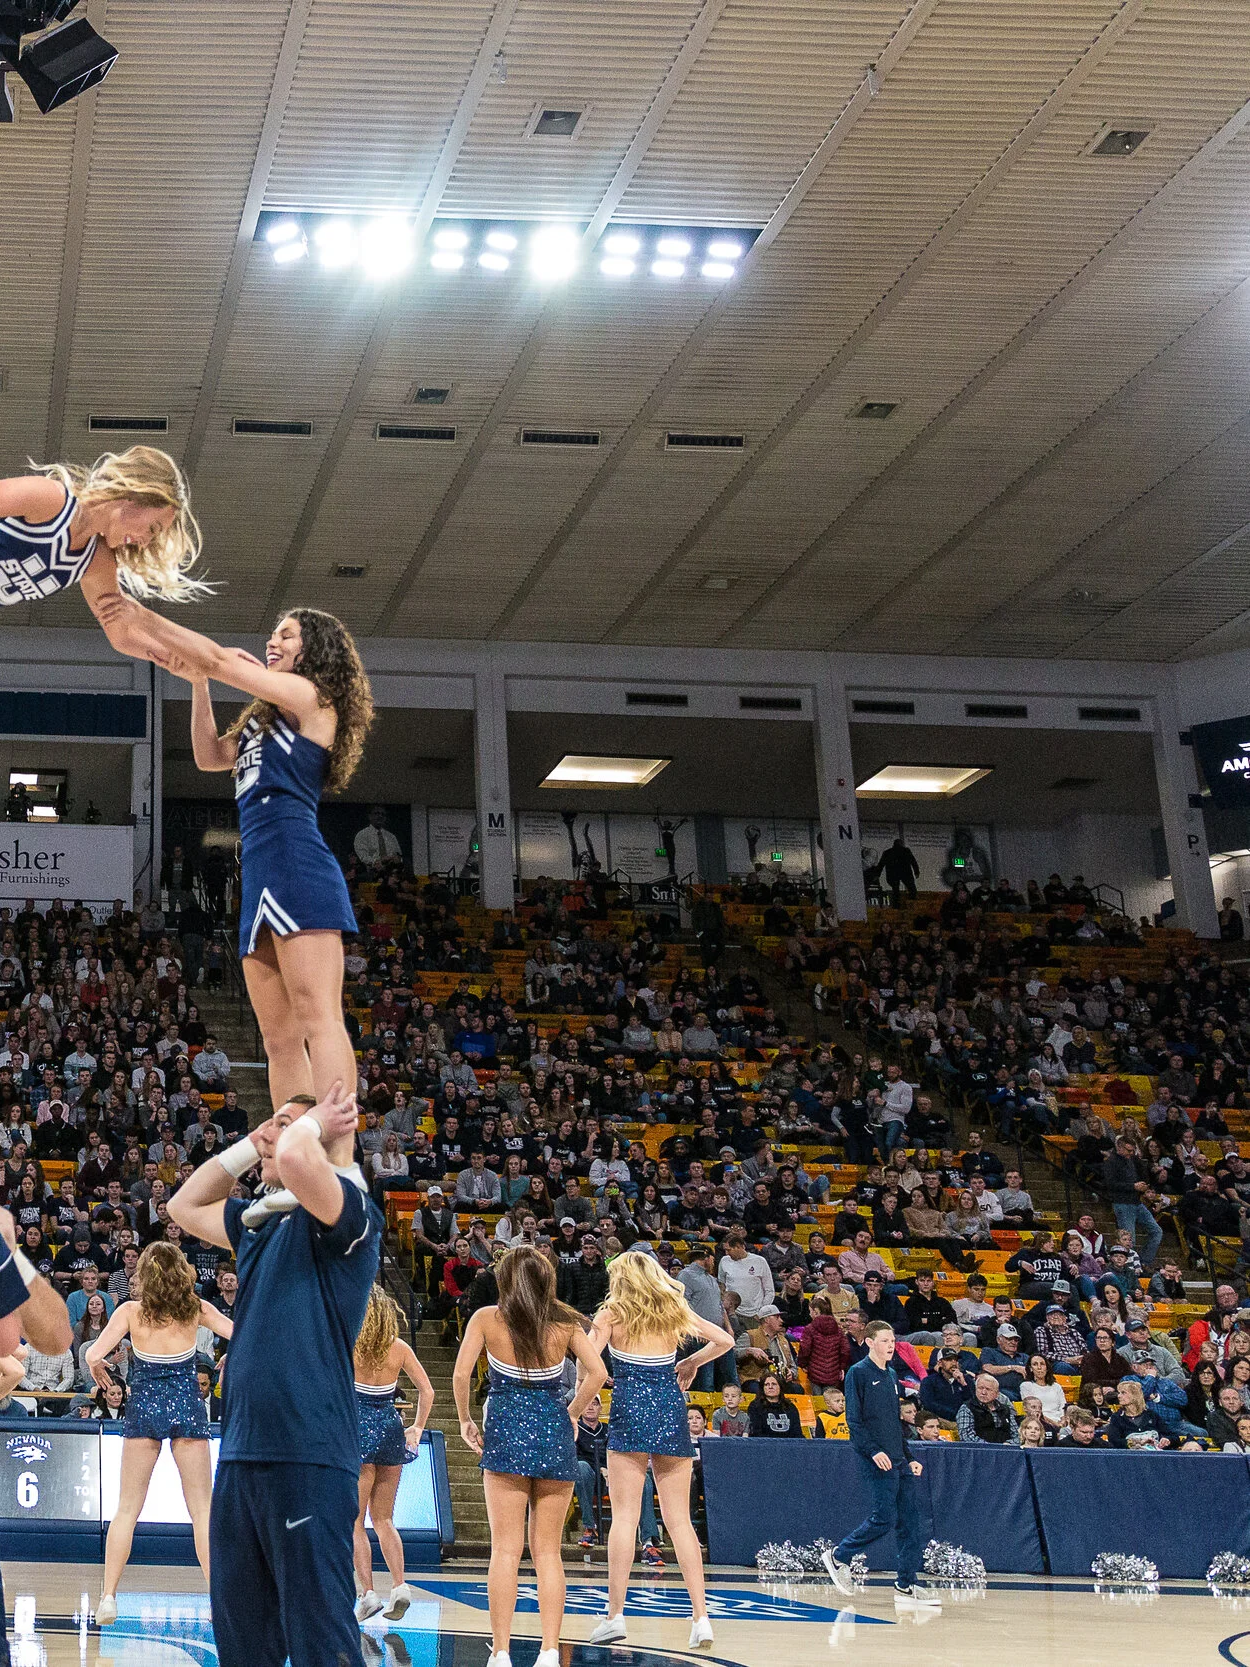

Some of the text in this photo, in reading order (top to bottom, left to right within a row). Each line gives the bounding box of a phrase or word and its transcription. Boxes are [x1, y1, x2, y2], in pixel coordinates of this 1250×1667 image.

[0, 559, 45, 601] STATE
[488, 812, 505, 828] M
[838, 824, 853, 840] N
[1187, 834, 1200, 849] P
[0, 872, 71, 888] Furnishings
[1032, 1258, 1061, 1271] UTAH
[5, 1434, 53, 1451] NEVADA
[16, 1471, 40, 1509] 6
